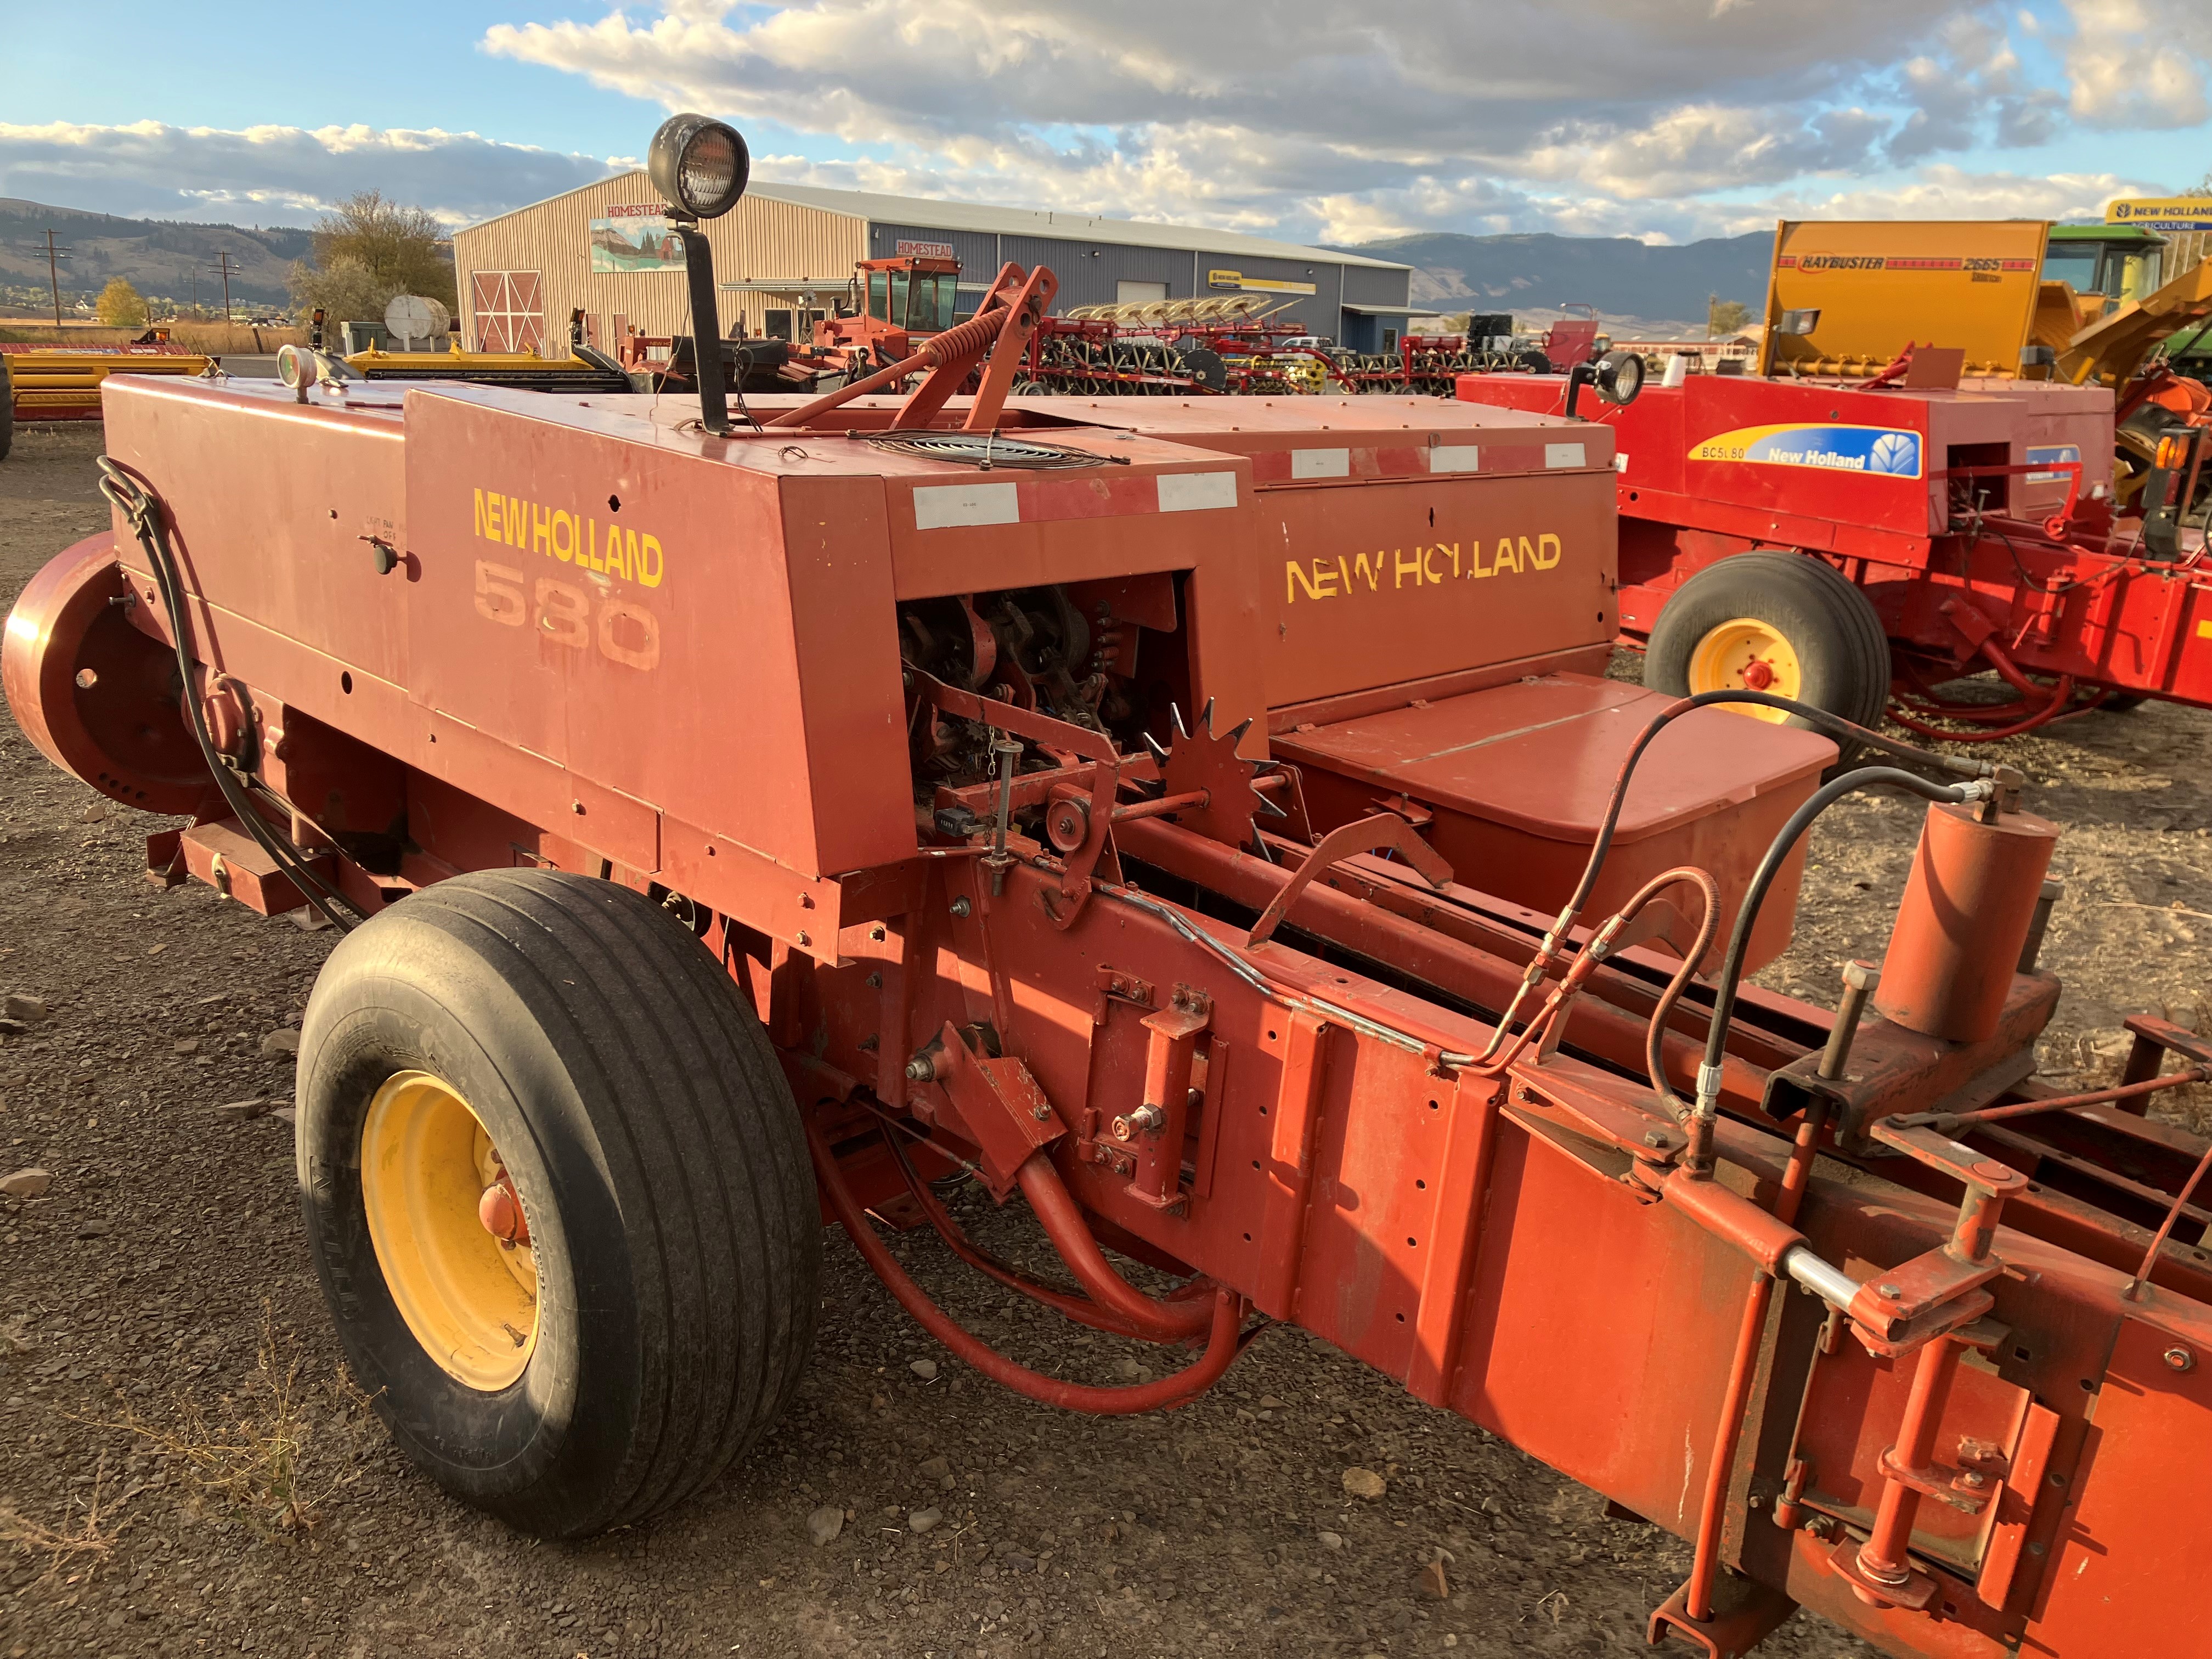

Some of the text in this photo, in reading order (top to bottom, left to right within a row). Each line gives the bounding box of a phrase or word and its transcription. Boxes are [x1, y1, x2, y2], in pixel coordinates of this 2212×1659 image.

[2134, 207, 2160, 216] NEW
[2132, 222, 2195, 230] AGRICULTURE
[898, 241, 952, 257] HOMESTEAD
[1802, 256, 1884, 269] HAYBUSTER
[1768, 448, 1803, 462] New
[1805, 449, 1865, 469] Holland
[475, 488, 663, 588] NEW HOLLAND
[1286, 550, 1385, 603] NEW
[475, 558, 659, 671] 580
